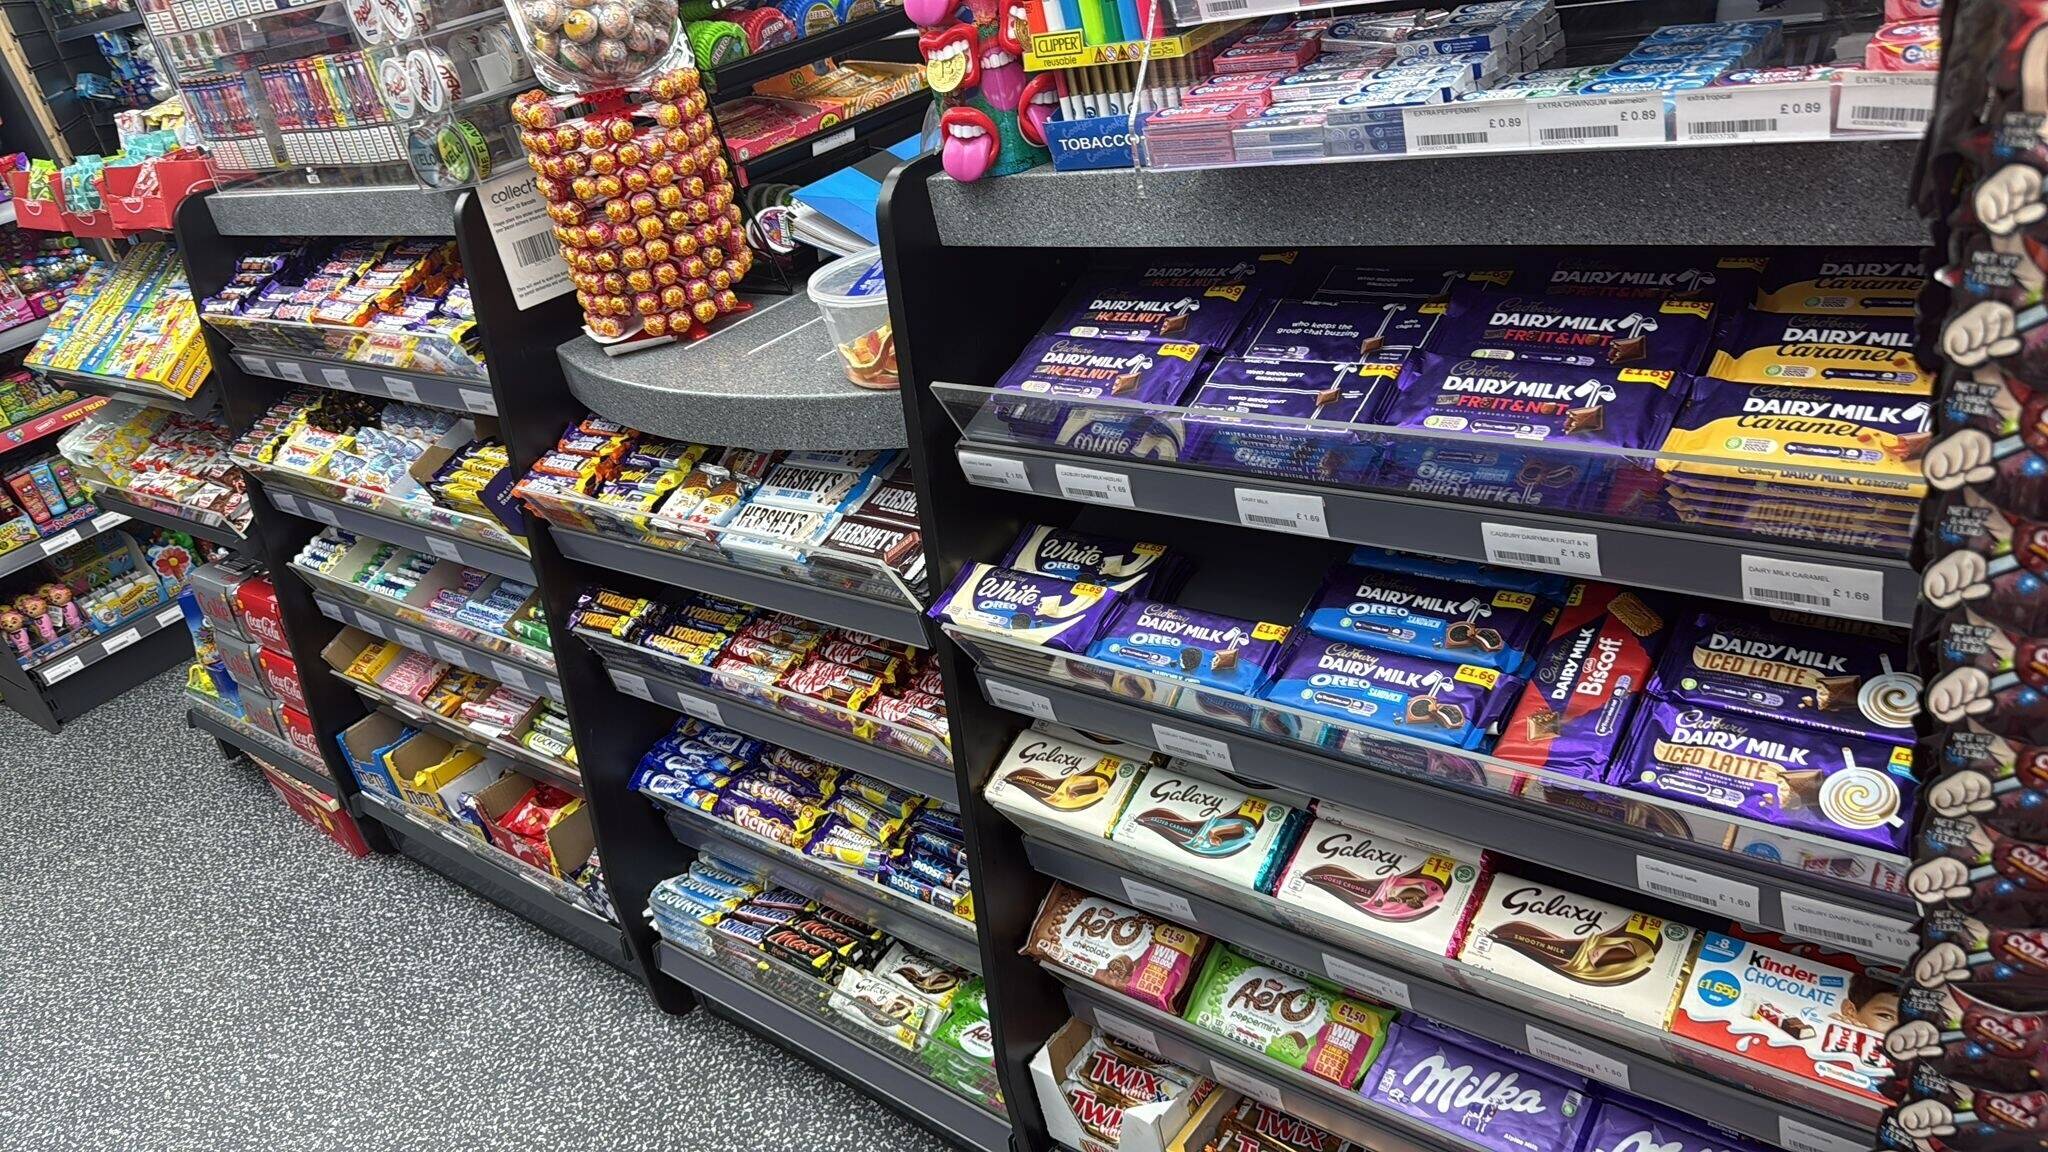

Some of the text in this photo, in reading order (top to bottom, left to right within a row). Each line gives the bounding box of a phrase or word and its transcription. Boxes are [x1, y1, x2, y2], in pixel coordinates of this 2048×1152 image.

[809, 10, 830, 19] BEBETO
[1334, 25, 1384, 38] extra
[1038, 36, 1079, 53] CLIPPER
[1043, 56, 1078, 67] reusable
[1686, 93, 1733, 102] extra tropical
[1620, 110, 1656, 121] £ 0.89
[1780, 102, 1821, 114] £ 0.89
[1489, 118, 1521, 128] £ 0.89
[414, 153, 437, 166] VELO
[443, 141, 464, 167] VELO
[1551, 270, 1677, 287] DAIRY MILK
[1819, 264, 1893, 277] DAIRY
[1089, 300, 1172, 312] DAIRY MILK
[1095, 311, 1167, 323] HAZELNUT
[1489, 312, 1618, 333] DAIRY MILK
[1782, 328, 1866, 344] DAIRY
[1041, 352, 1129, 370] DAIRY MILK
[1776, 343, 1898, 362] Caramel
[1048, 365, 1119, 381] HAZELNUT
[1450, 360, 1520, 381] Cadbury
[1442, 376, 1576, 401] DAIRY MILK
[62, 399, 107, 421] SWEET TREATS
[1742, 397, 1904, 425] DAIRY MILK
[1737, 415, 1864, 438] Caramel
[621, 469, 647, 482] Twirl
[767, 467, 843, 493] HERSHEY'S
[1304, 514, 1321, 523] 1.69
[318, 541, 336, 552] POLO
[831, 521, 904, 553] HERSHEY'S
[1490, 530, 1521, 540] CADBURY
[1521, 533, 1555, 542] DAIRYMILK
[1555, 537, 1575, 545] FRUIT
[1041, 538, 1101, 568] White
[1136, 541, 1165, 553] £1.69
[301, 557, 321, 570] POLO
[1042, 560, 1081, 571] OREO
[1748, 566, 1832, 583] DAIRY MILK CARAMEL
[978, 577, 1039, 607] White
[1074, 583, 1103, 596] £1.69
[1833, 588, 1871, 602] £ 1.69
[596, 591, 637, 613] YORKIE
[979, 599, 1018, 612] OREO
[1347, 602, 1410, 618] OREO
[1356, 585, 1461, 616] DAIRY MILK
[468, 606, 499, 620] mentos
[581, 611, 619, 630] YORKIE
[1137, 615, 1224, 644] DAIRY MILK
[1258, 622, 1289, 637] £1.69
[1129, 631, 1182, 648] OREO
[1325, 643, 1380, 666] Cadbury
[1709, 633, 1850, 674] DAIRY MILK
[1318, 654, 1422, 689] DAIRY MILK
[1703, 651, 1808, 687] ICED LATTE
[1309, 673, 1372, 691] OREO
[1675, 709, 1749, 736] Cadbury
[533, 734, 565, 753] LOCKETS
[1672, 727, 1812, 767] DAIRY MILK
[1019, 741, 1086, 777] Galaxy
[1663, 745, 1703, 767] ICED
[1708, 749, 1770, 780] LATTE
[1150, 779, 1227, 817] Galaxy
[734, 804, 782, 841] Picnic
[1316, 833, 1407, 876] Galaxy
[913, 860, 942, 879] BOOST
[1427, 855, 1454, 874] £1.50
[682, 877, 730, 902] BOUNTY
[891, 874, 919, 895] BOOST
[658, 891, 709, 918] BOUNTY
[1502, 887, 1608, 936] Galaxy
[1728, 896, 1751, 908] 1.69
[1066, 906, 1144, 947] Aero
[1632, 913, 1662, 932] £1.50
[1162, 928, 1185, 944] £1.50
[1514, 934, 1566, 956] SMOOTH MILK
[1886, 934, 1911, 947] 1.69
[1072, 940, 1111, 960] chocolate
[1155, 944, 1180, 963] WIN
[901, 953, 939, 974] Galaxy
[1749, 950, 1818, 985] Kinder
[856, 978, 890, 1001] Galaxy
[1743, 967, 1837, 1007] CHOCOLATE
[1227, 977, 1317, 1023] Aero
[1230, 1010, 1282, 1036] peppermint
[1338, 1005, 1367, 1024] £1.50
[1332, 1024, 1360, 1046] WIN
[1979, 1015, 2026, 1050] COLA
[1315, 1064, 1340, 1080] BAR
[1318, 1055, 1344, 1071] LESS
[1603, 1066, 1623, 1078] 1.50
[1090, 1050, 1164, 1101] TWIX white
[1402, 1054, 1547, 1115] Milka
[1989, 1098, 2038, 1129] COLA
